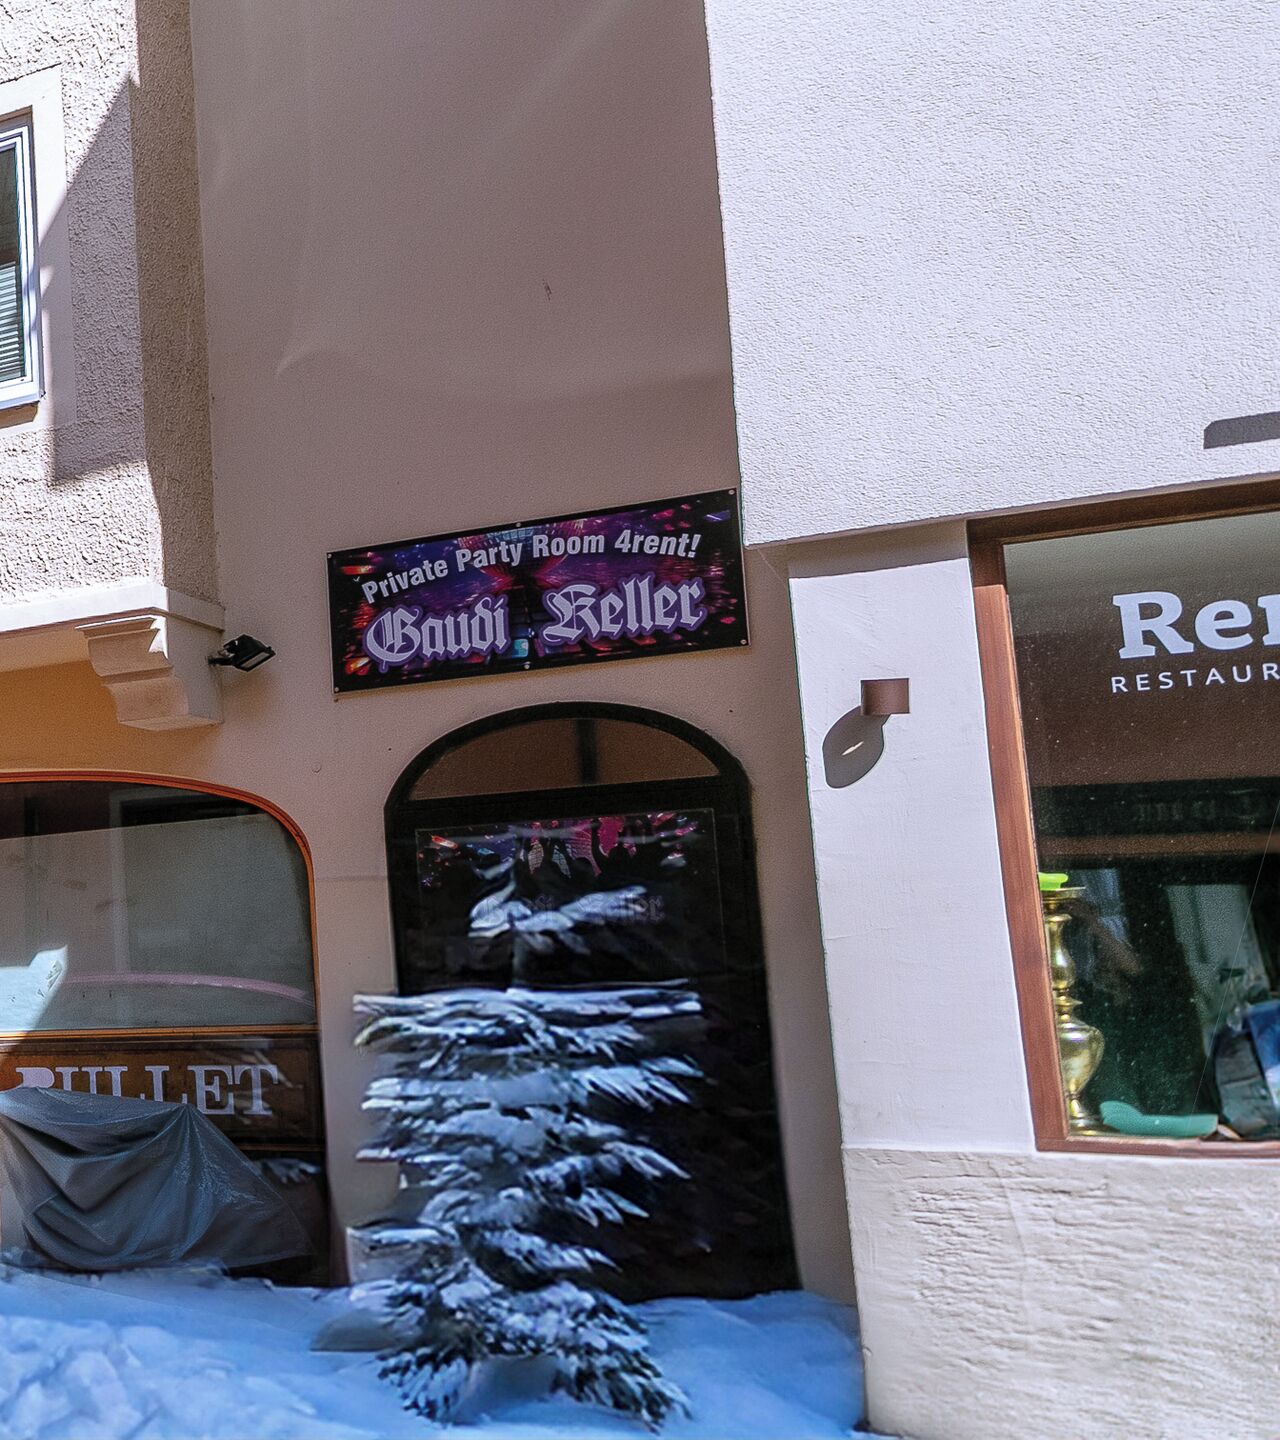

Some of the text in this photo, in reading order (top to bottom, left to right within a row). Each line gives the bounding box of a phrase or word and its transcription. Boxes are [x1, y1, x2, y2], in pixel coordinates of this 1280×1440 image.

[361, 529, 702, 605] Private Party Room 4rent!
[365, 574, 706, 666] Gaudi Keller
